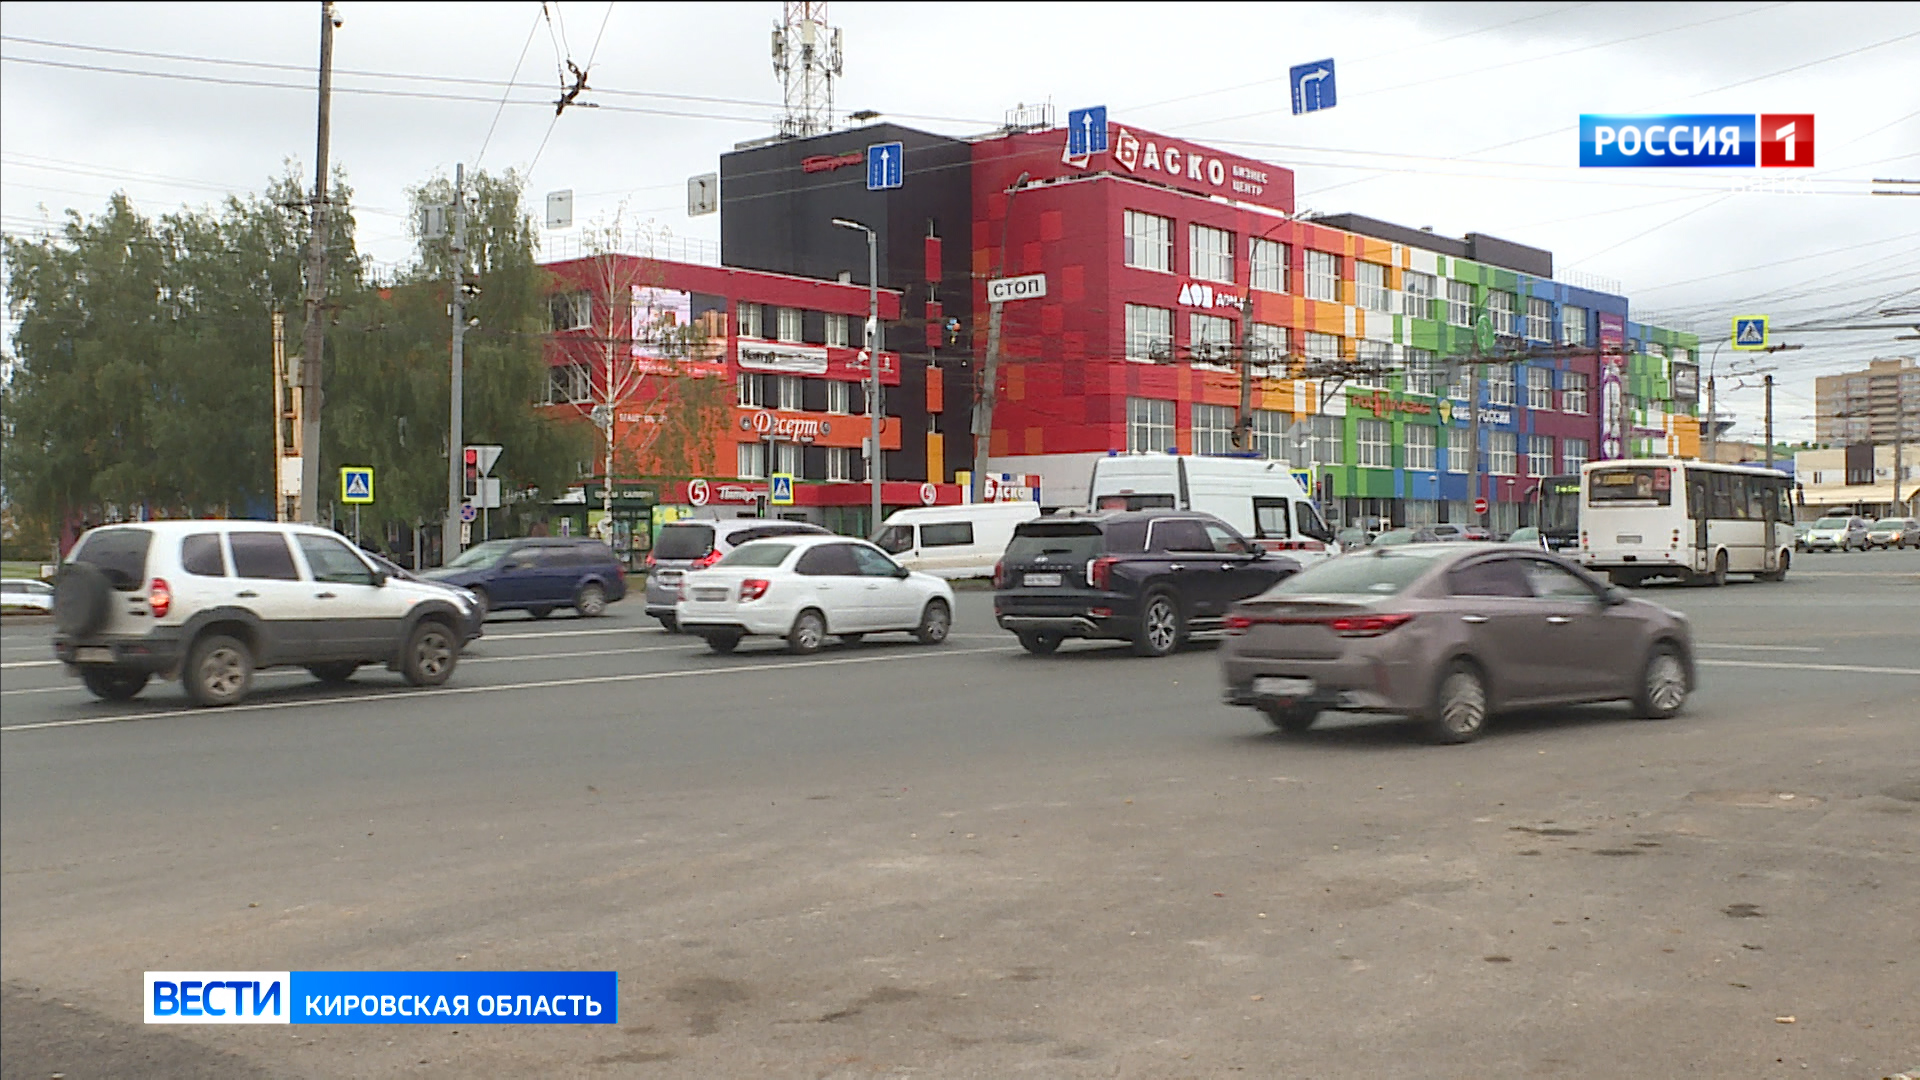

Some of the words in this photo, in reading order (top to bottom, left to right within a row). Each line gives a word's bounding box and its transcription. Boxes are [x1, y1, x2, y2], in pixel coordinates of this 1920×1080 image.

[1117, 130, 1225, 186] БАСКО
[1232, 165, 1268, 184] БИЗНЕС
[1232, 180, 1263, 196] ЦЕНТР
[994, 279, 1039, 297] СТОП
